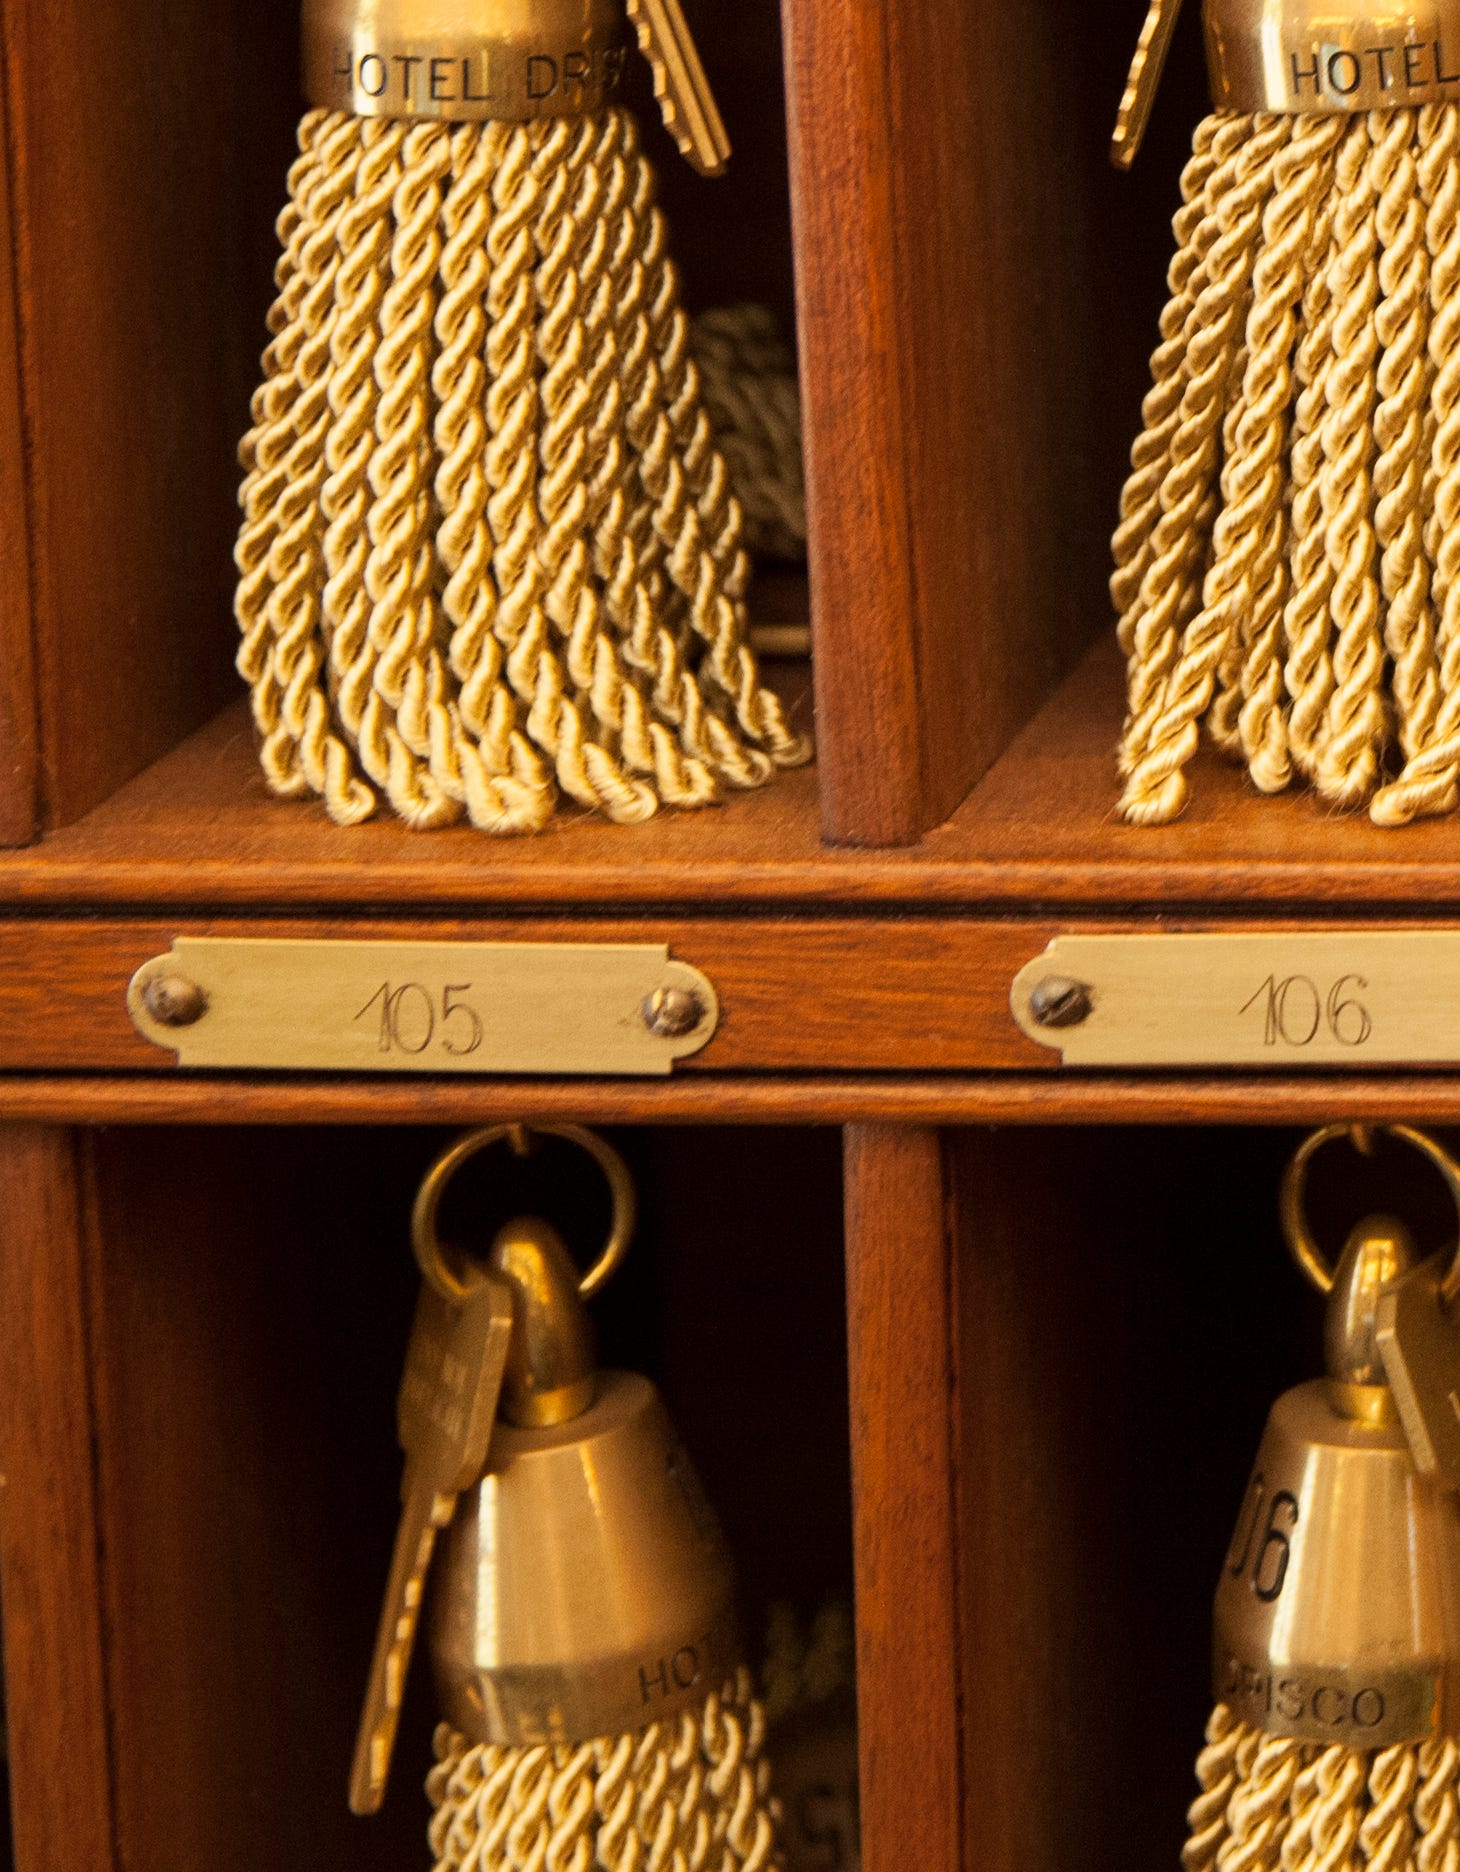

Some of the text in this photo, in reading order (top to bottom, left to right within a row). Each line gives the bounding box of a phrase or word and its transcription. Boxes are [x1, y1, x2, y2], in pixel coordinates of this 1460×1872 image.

[331, 50, 497, 102] HOTEL
[1289, 40, 1460, 97] HOTEL
[352, 979, 484, 1057] 105
[1238, 972, 1374, 1047] 106
